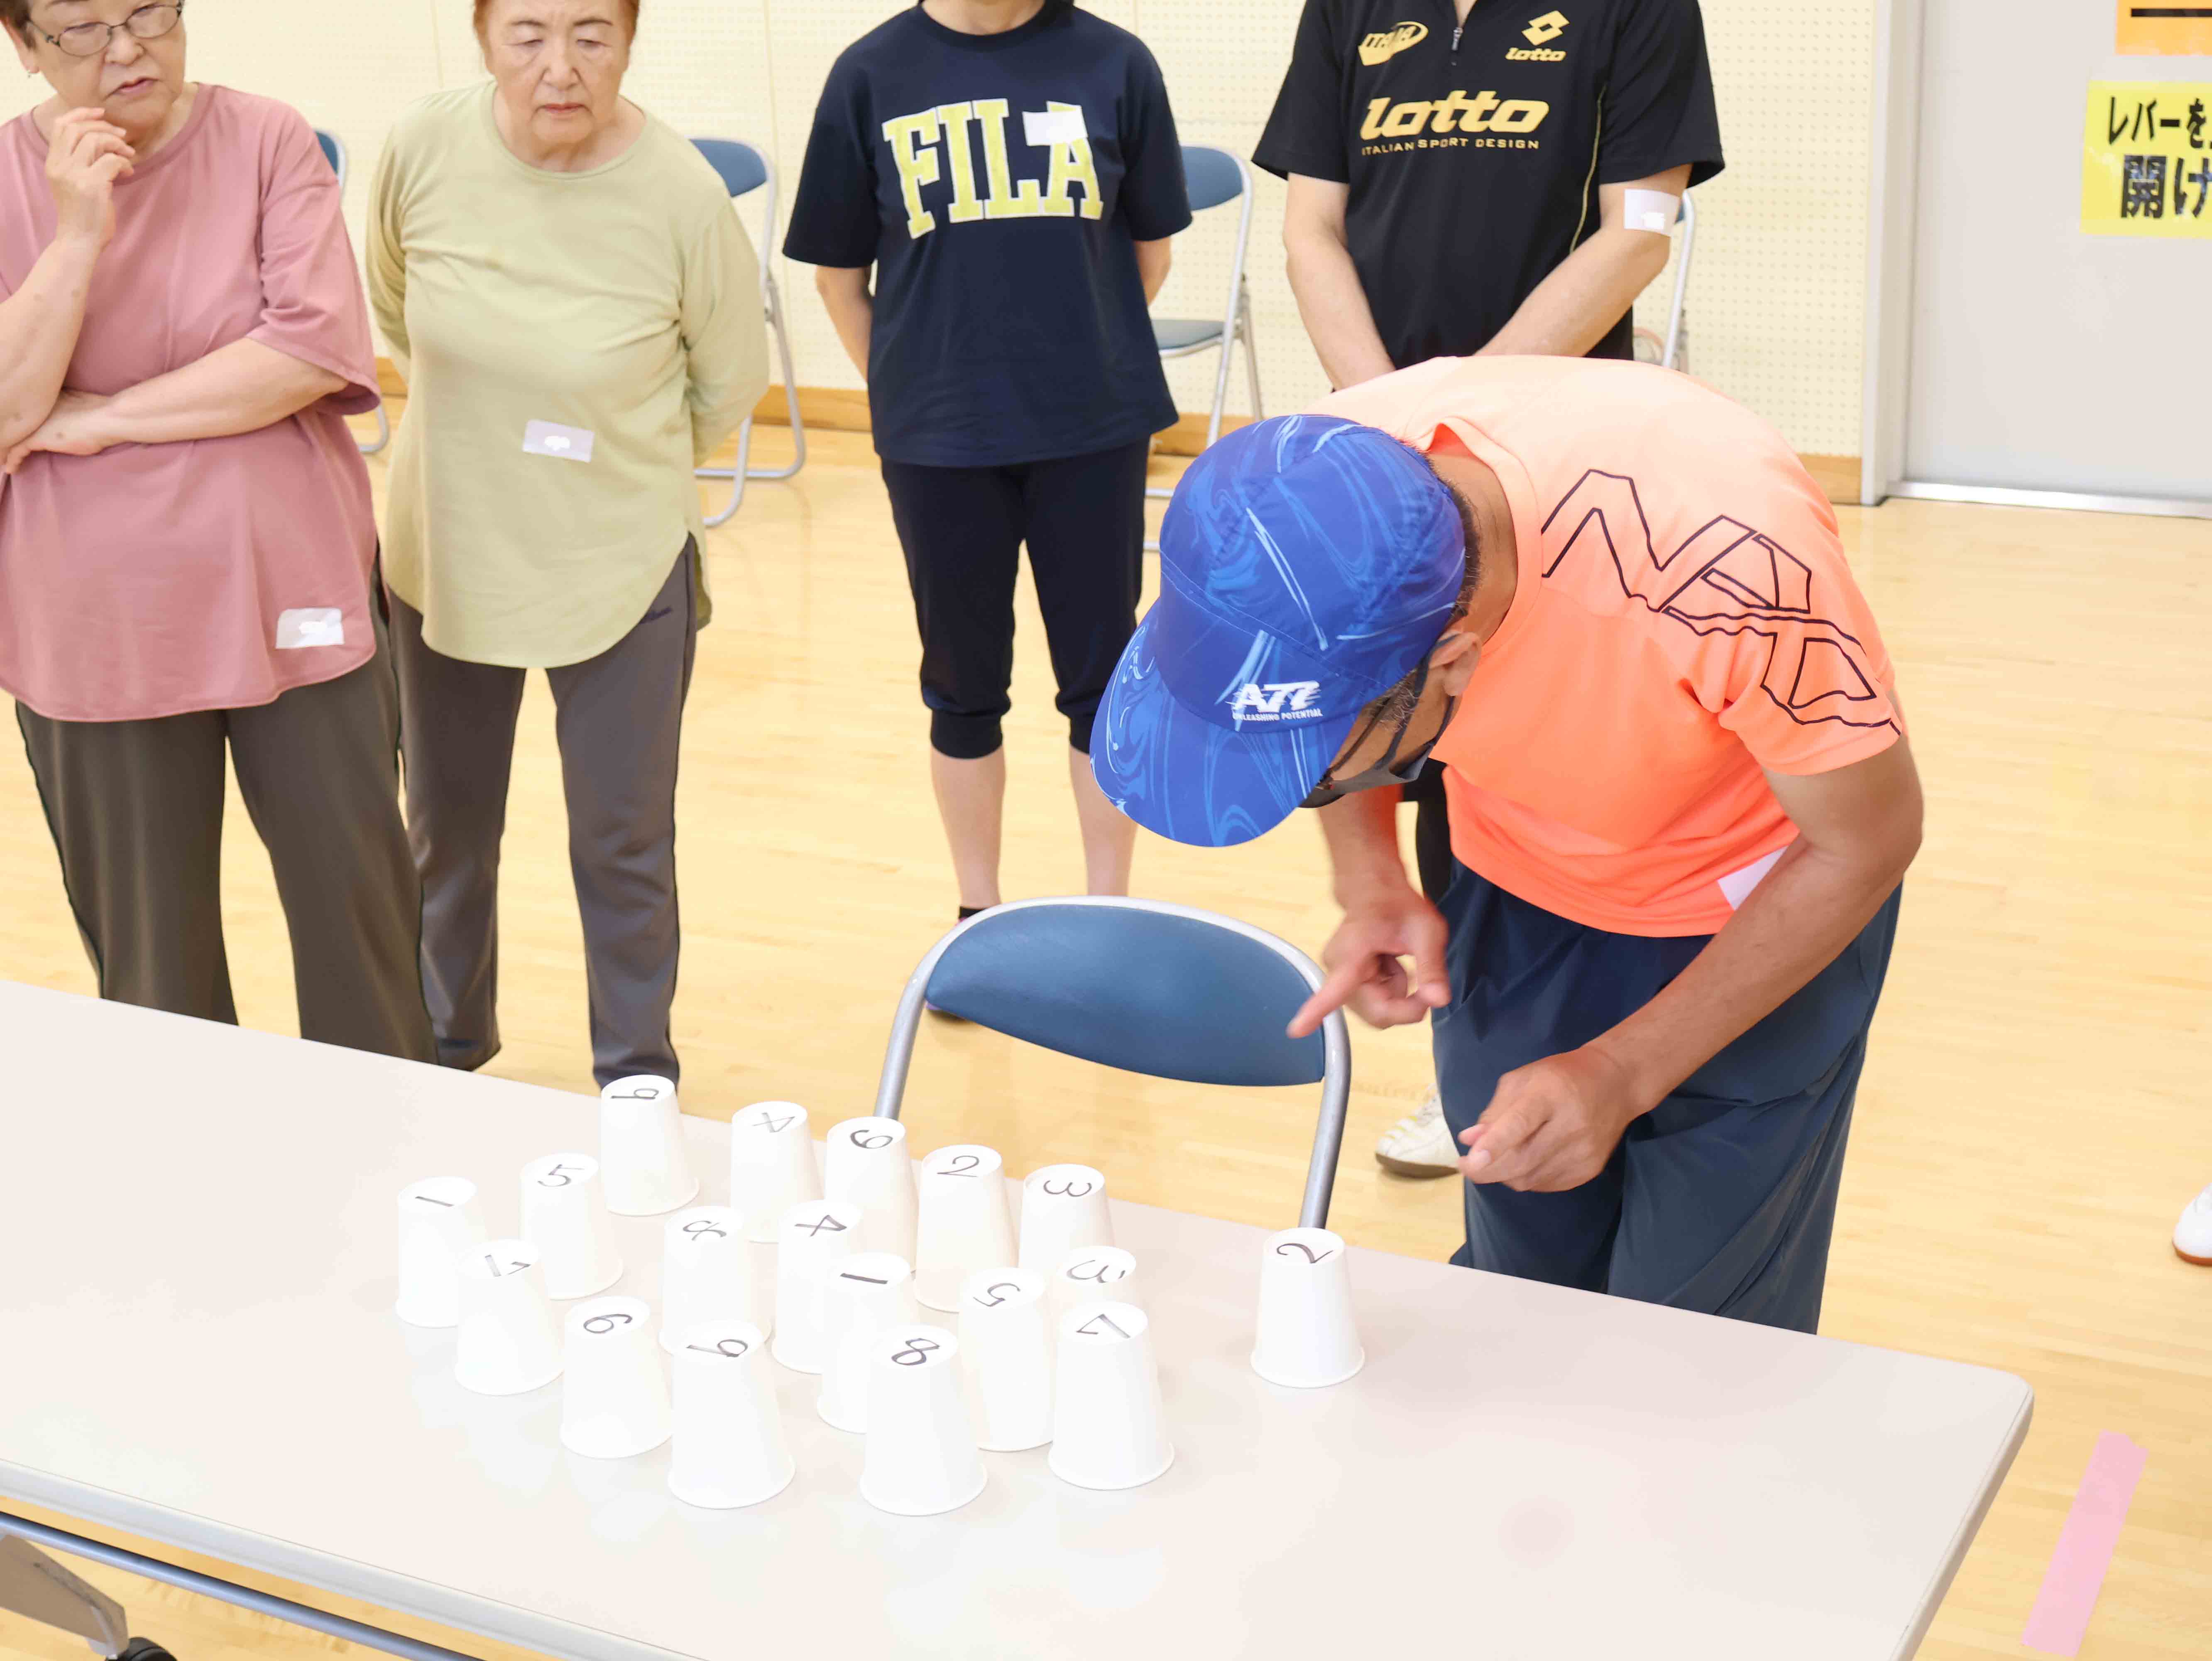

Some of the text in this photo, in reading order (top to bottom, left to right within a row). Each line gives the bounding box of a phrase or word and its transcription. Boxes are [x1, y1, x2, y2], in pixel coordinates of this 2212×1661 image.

[1505, 47, 1566, 61] lotto
[1360, 90, 1549, 140] lotto
[2108, 96, 2212, 149] レバーを
[1361, 137, 1540, 156] ITALIAN SPORT DESIGN
[882, 98, 1104, 239] FILA
[2121, 154, 2212, 218] 開け
[1281, 708, 1323, 720] POTENTIAL
[752, 1112, 795, 1133] 4
[538, 1164, 585, 1187] 5
[937, 1155, 980, 1177] 2
[1043, 1180, 1092, 1197] 3
[795, 1215, 847, 1237] 4
[1276, 1242, 1334, 1264] 2
[973, 1283, 1020, 1307] 5
[1076, 1313, 1131, 1339] 7
[891, 1338, 940, 1366] 8
